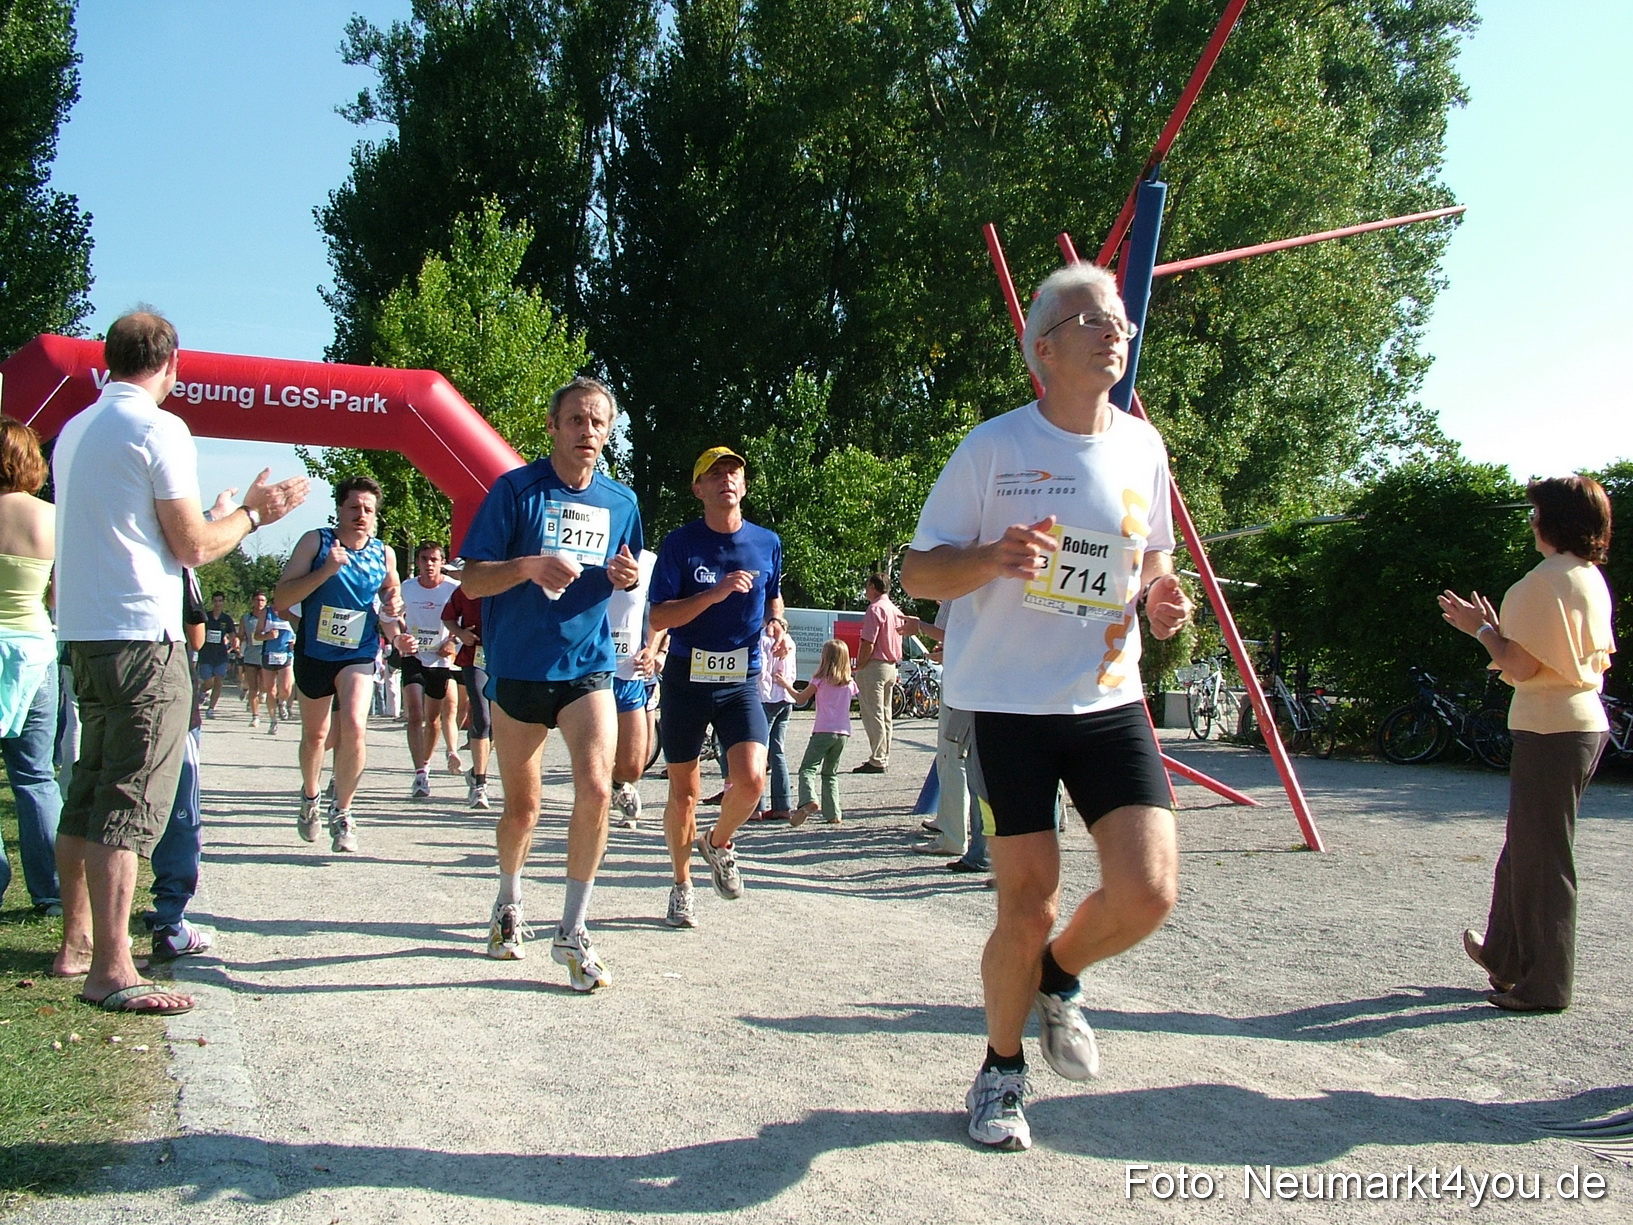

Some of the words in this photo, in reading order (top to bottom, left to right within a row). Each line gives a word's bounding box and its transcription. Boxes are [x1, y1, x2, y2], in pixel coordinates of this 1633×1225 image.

[264, 384, 388, 414] LGS-Park
[996, 488, 1042, 497] finisher
[1047, 487, 1076, 495] 2003
[562, 508, 590, 522] Alfons
[547, 522, 555, 532] B
[561, 528, 605, 549] 2177
[1061, 536, 1109, 559] Robert
[1059, 565, 1107, 596] 714
[332, 612, 350, 621] Josef
[331, 624, 347, 637] 82
[418, 637, 434, 646] 287
[614, 642, 628, 654] 78
[695, 651, 702, 660] C
[707, 656, 736, 670] 618
